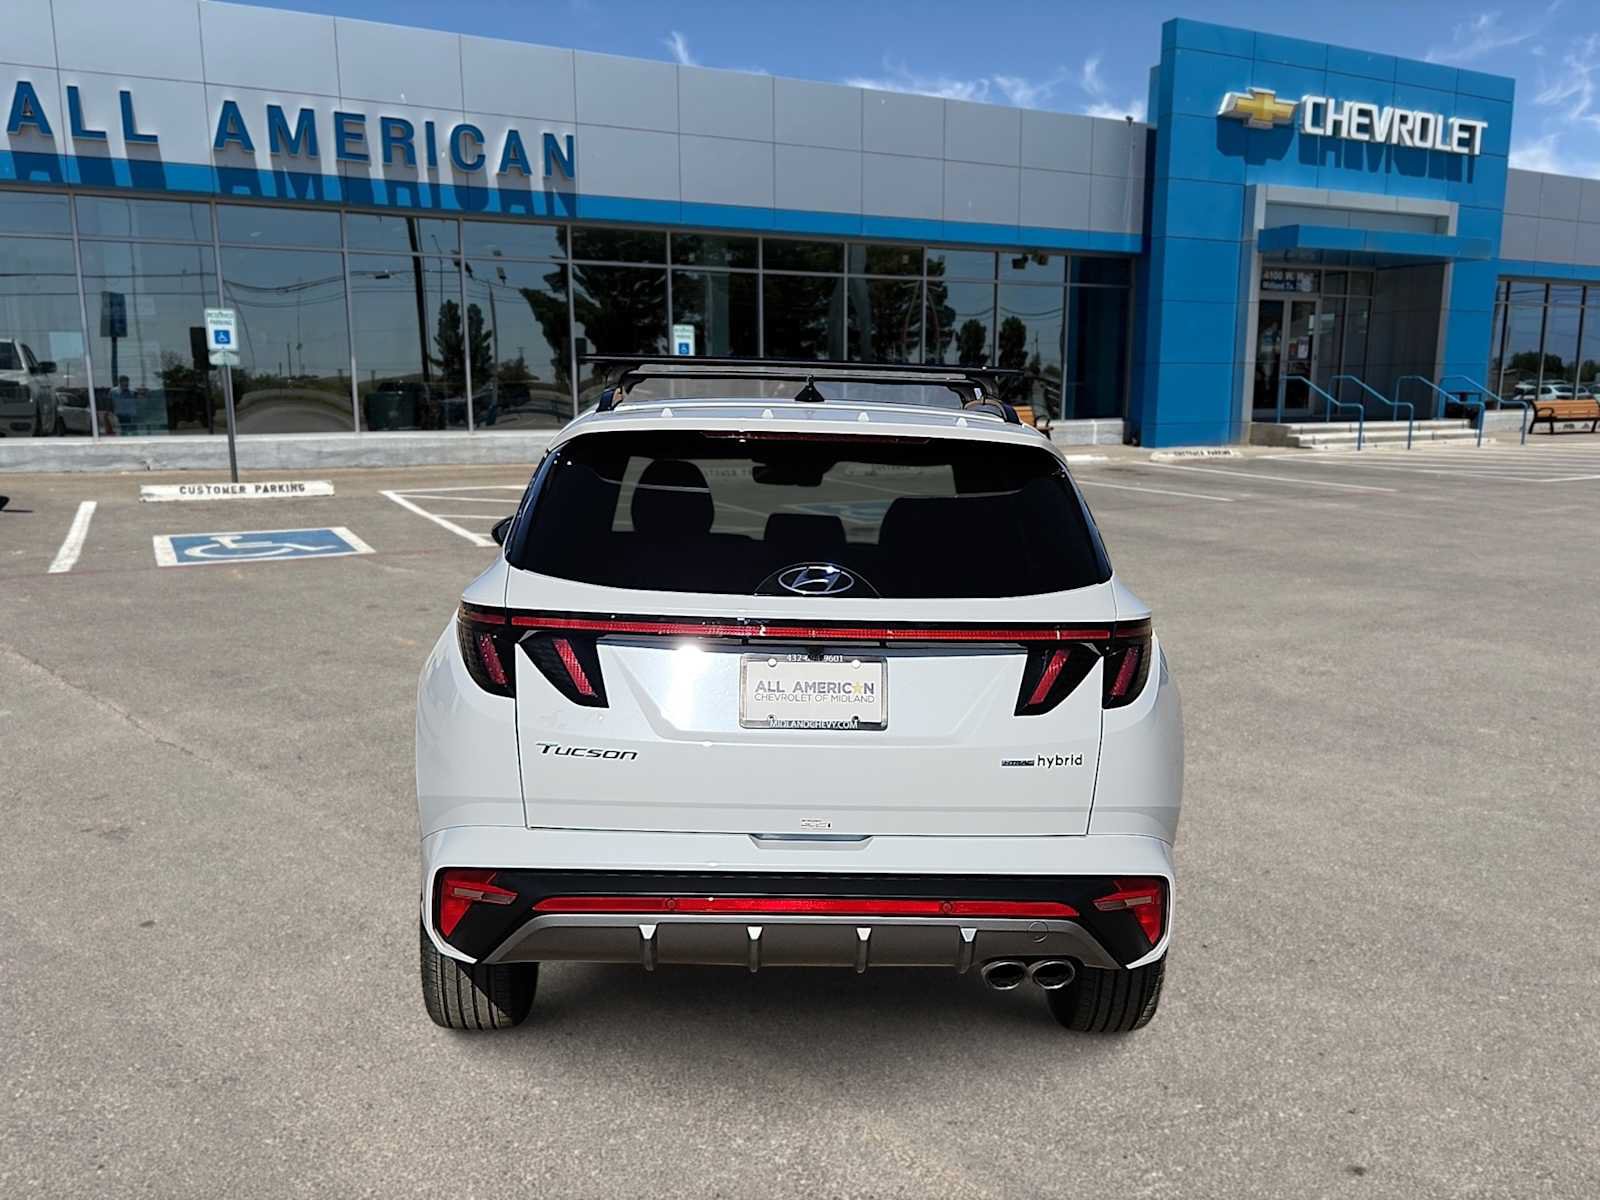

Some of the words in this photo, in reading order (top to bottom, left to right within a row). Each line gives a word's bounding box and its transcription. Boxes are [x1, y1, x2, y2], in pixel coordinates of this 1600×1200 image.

[6, 80, 159, 144] ALL
[213, 99, 576, 179] AMERICAN
[1301, 94, 1489, 156] CHEVROLET
[179, 485, 246, 496] CUSTOMER
[254, 483, 306, 494] PARKING
[754, 680, 786, 693] ALL
[753, 693, 812, 703] CHEVROLET
[814, 694, 829, 703] OF
[830, 695, 875, 704] MIDLAND
[769, 719, 858, 729] MIDLANDCHEVY.COM
[1037, 754, 1083, 768] hybrid
